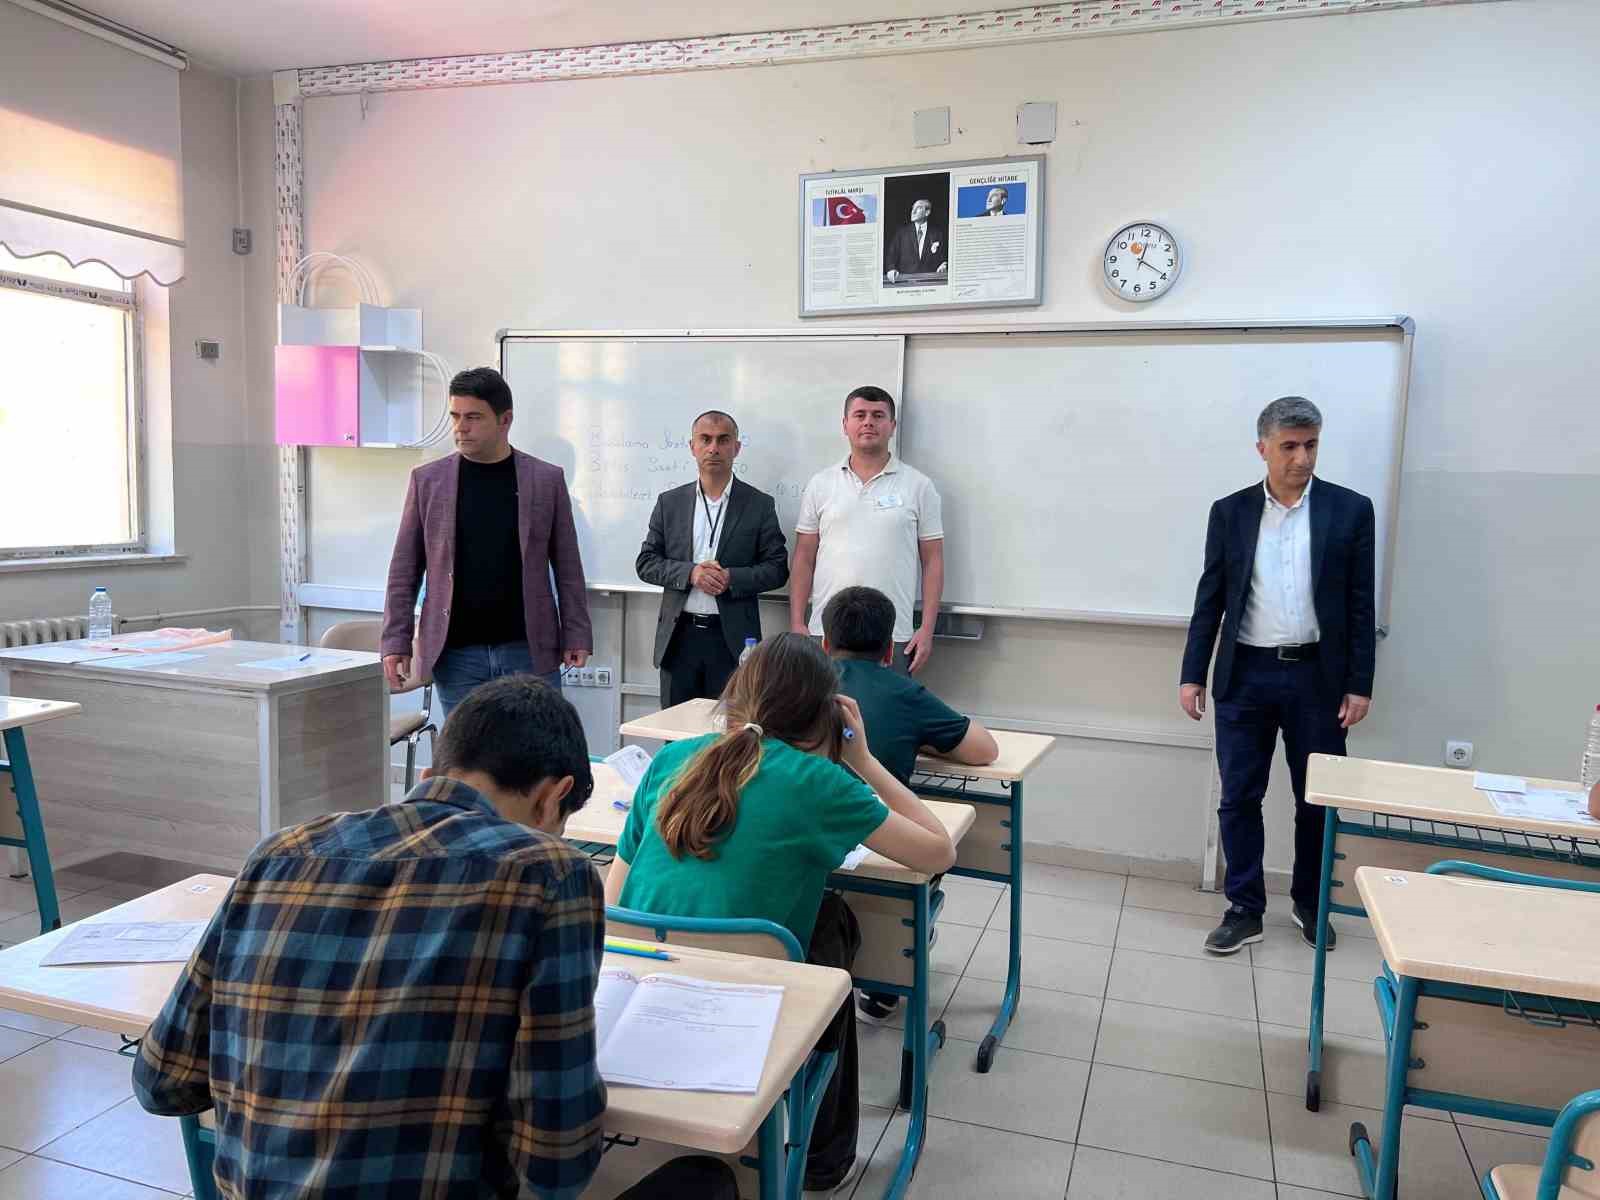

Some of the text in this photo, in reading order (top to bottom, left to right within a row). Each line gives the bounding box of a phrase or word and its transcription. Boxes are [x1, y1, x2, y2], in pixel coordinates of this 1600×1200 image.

[1128, 232, 1135, 240] 11
[1141, 228, 1151, 238] 12
[1117, 240, 1128, 249] 10
[1164, 244, 1171, 252] 2
[1109, 255, 1117, 263] 9
[1167, 258, 1174, 267] 3
[1111, 269, 1119, 278] 8
[1160, 272, 1168, 280] 4
[1120, 279, 1127, 288] 7
[1149, 281, 1157, 289] 5
[1133, 284, 1141, 292] 6
